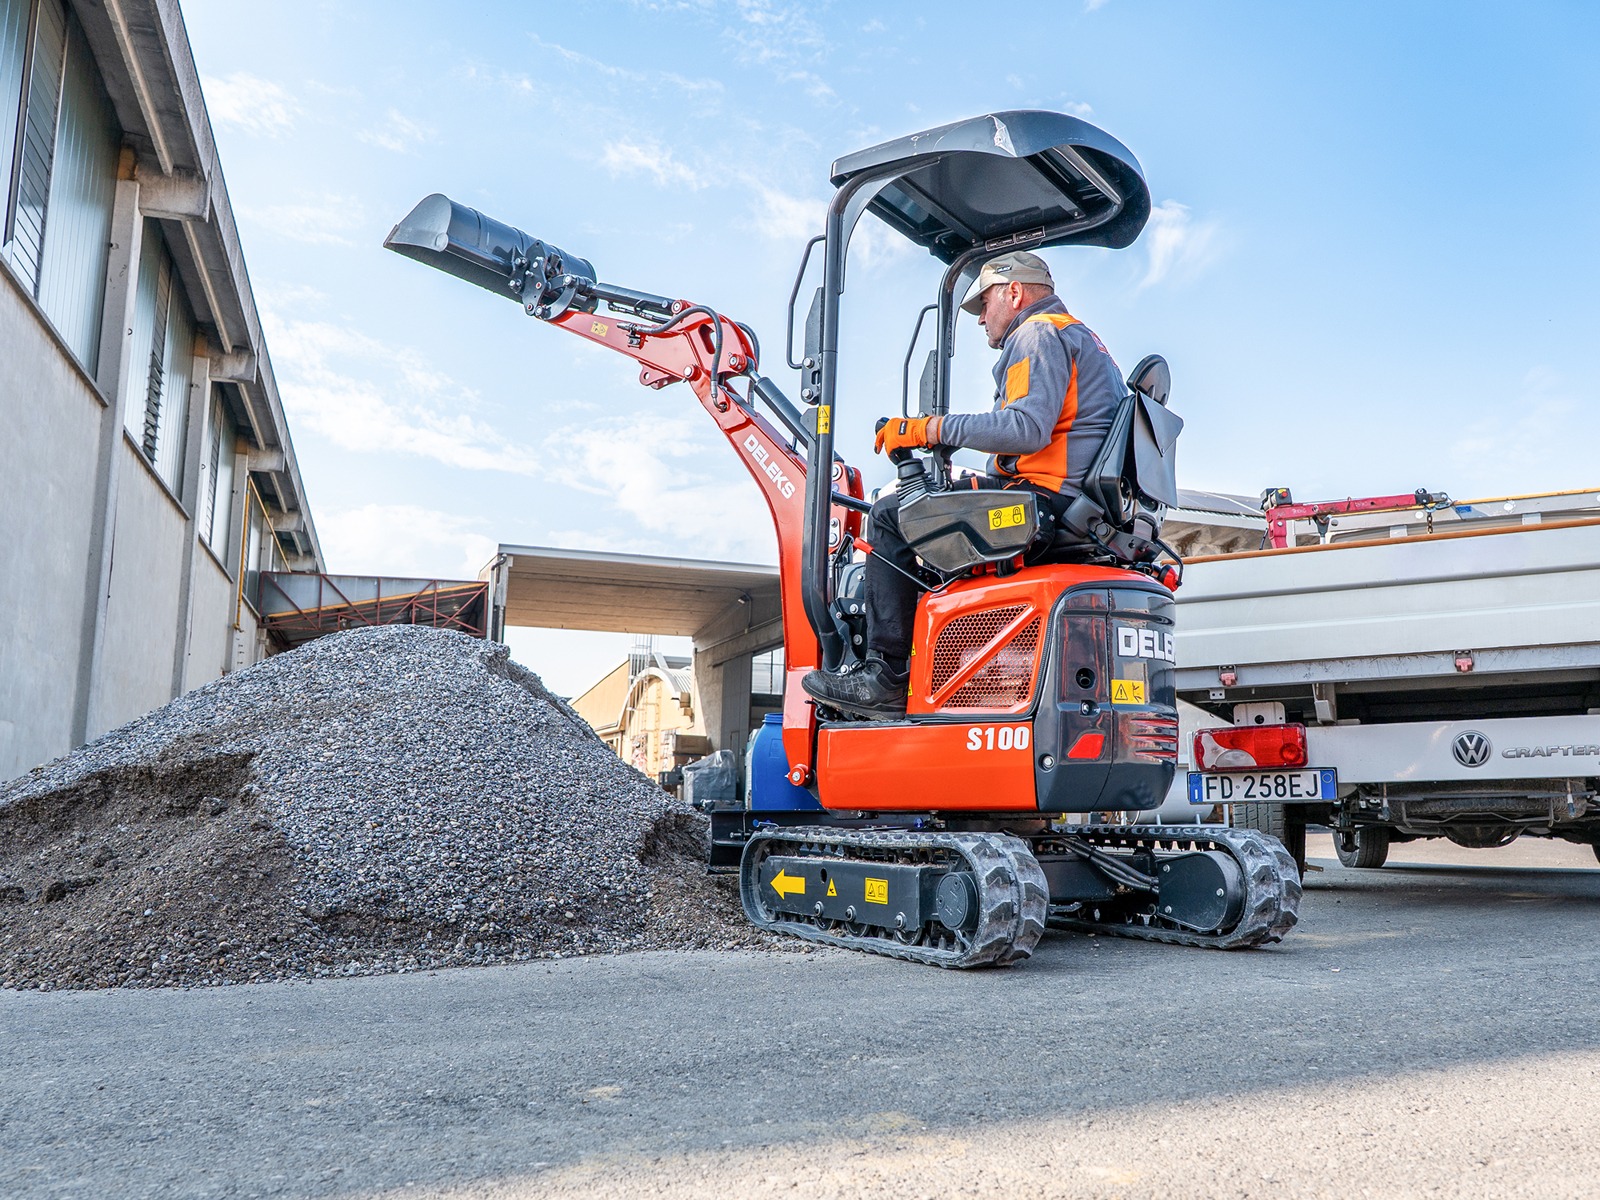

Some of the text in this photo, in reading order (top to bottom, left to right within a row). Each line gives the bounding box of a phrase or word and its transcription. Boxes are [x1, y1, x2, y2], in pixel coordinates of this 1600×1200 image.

[743, 433, 796, 500] DELEKS
[966, 726, 1030, 751] S100
[1501, 744, 1600, 759] CRAFTER
[1205, 773, 1319, 800] FD 258EJ
